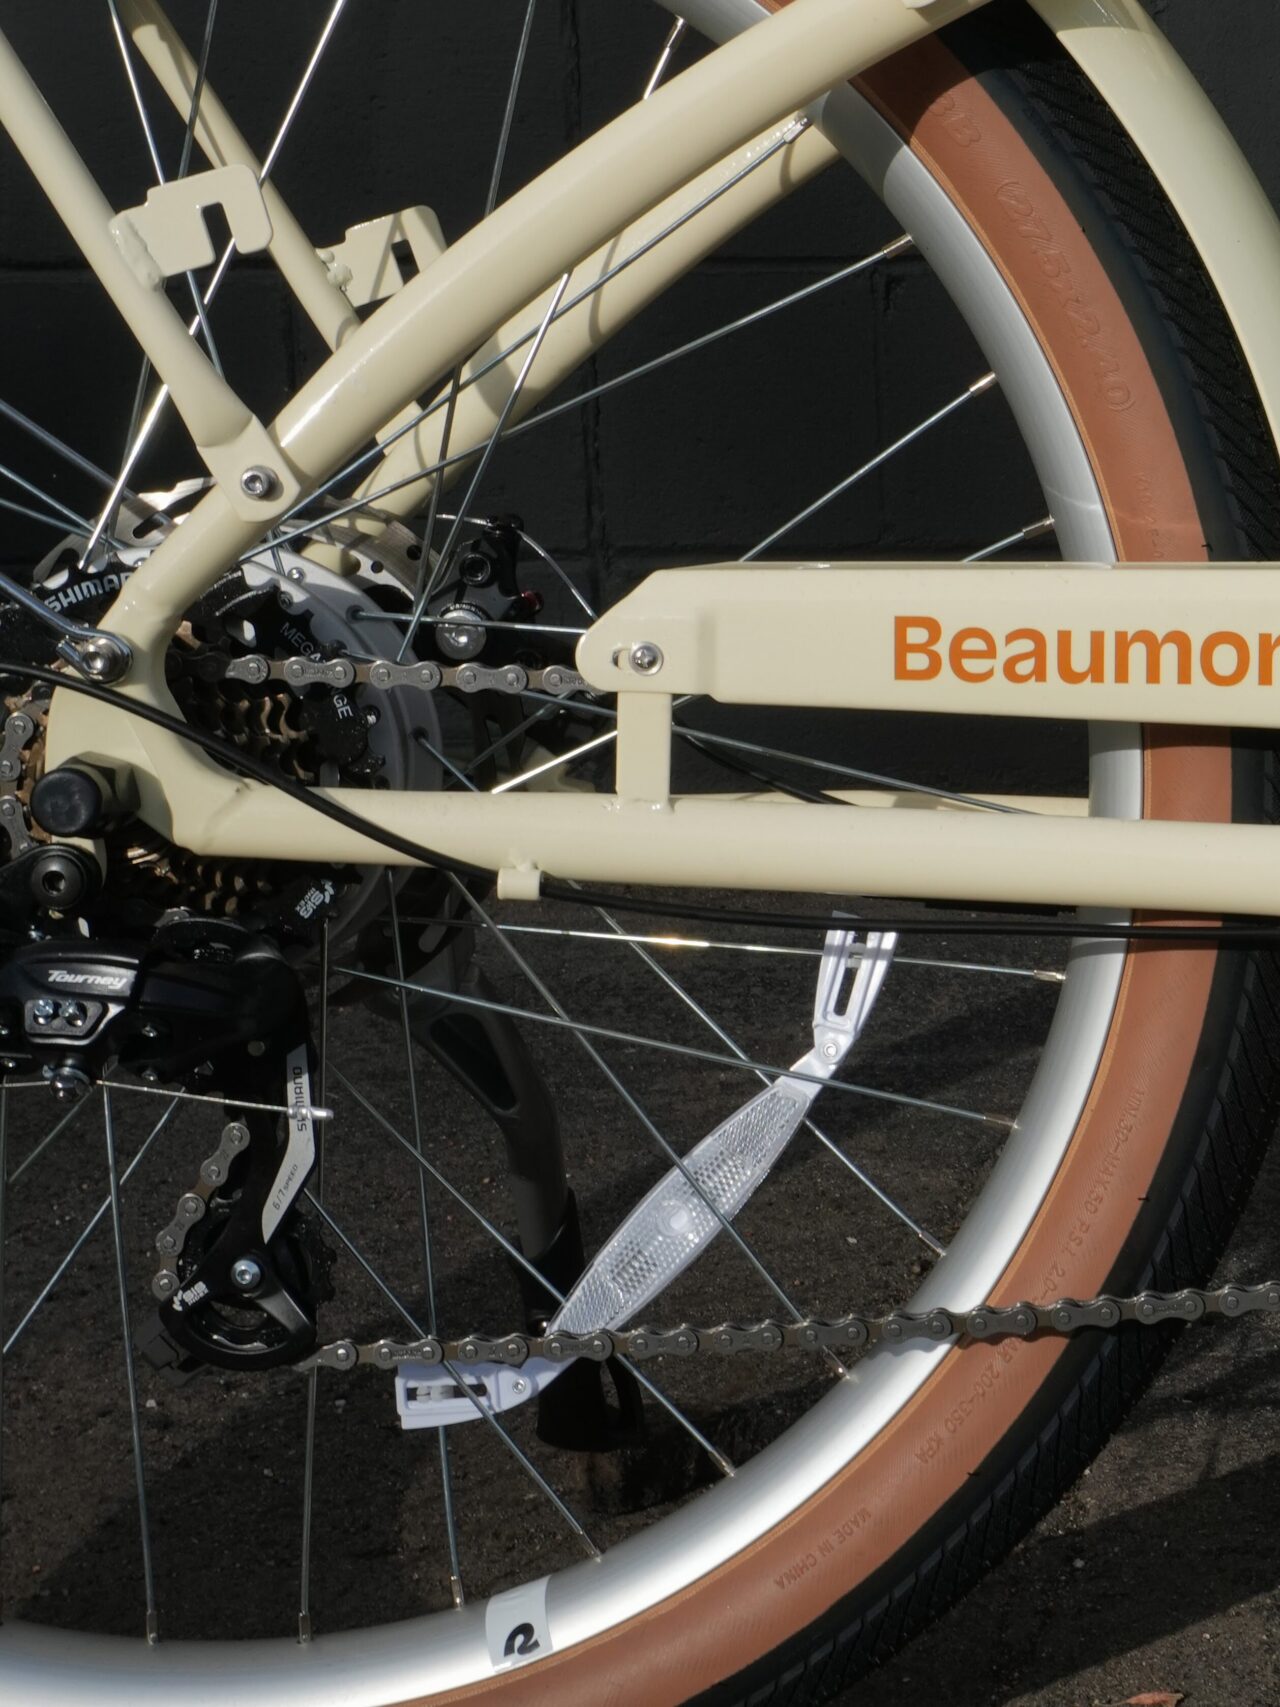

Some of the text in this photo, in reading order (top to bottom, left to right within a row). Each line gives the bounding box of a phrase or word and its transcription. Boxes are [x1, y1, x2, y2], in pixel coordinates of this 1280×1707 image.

[43, 572, 133, 613] SHIMA
[47, 969, 128, 990] Tourney
[292, 1066, 307, 1132] SMANO
[945, 1365, 1001, 1434] 200-350
[914, 1436, 946, 1465] KPA
[773, 1507, 872, 1590] MADE IN CHINA
